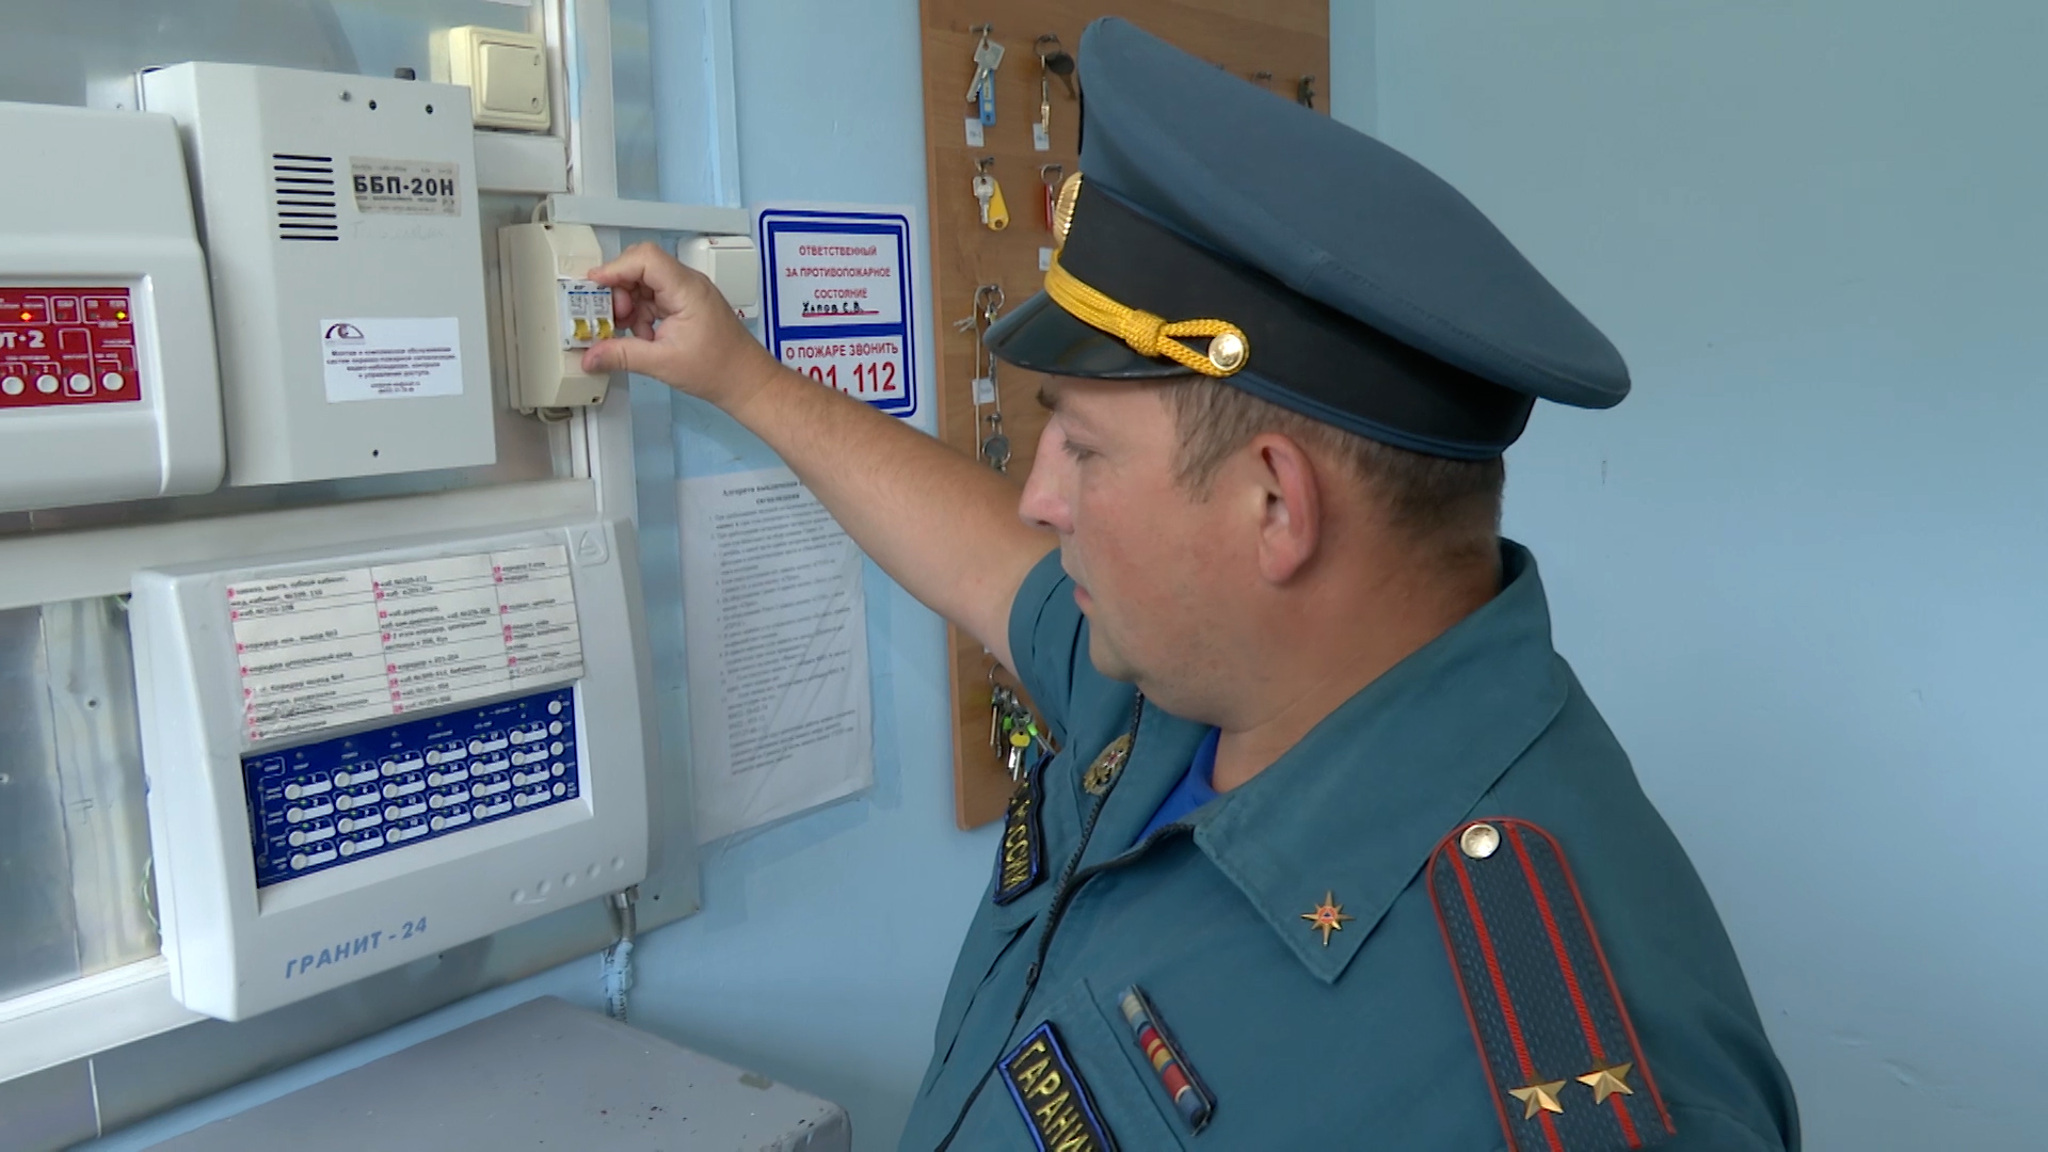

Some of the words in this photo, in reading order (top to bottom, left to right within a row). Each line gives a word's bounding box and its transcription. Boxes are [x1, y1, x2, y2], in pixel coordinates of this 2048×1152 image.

[798, 245, 877, 256] ОТВЕТСТВЕННЫЙ
[785, 268, 798, 277] ЗА
[800, 268, 891, 277] ПРОТИВОПОЖАРНОЕ
[814, 288, 867, 299] СОСТОЯНИЕ
[785, 347, 795, 359] О
[798, 344, 846, 358] ПОЖАРЕ
[849, 342, 898, 356] ЗВОНИТЬ
[285, 930, 382, 979] ГРАНИТ
[402, 916, 427, 940] 24
[1012, 1040, 1092, 1152] ГАРАНИ
